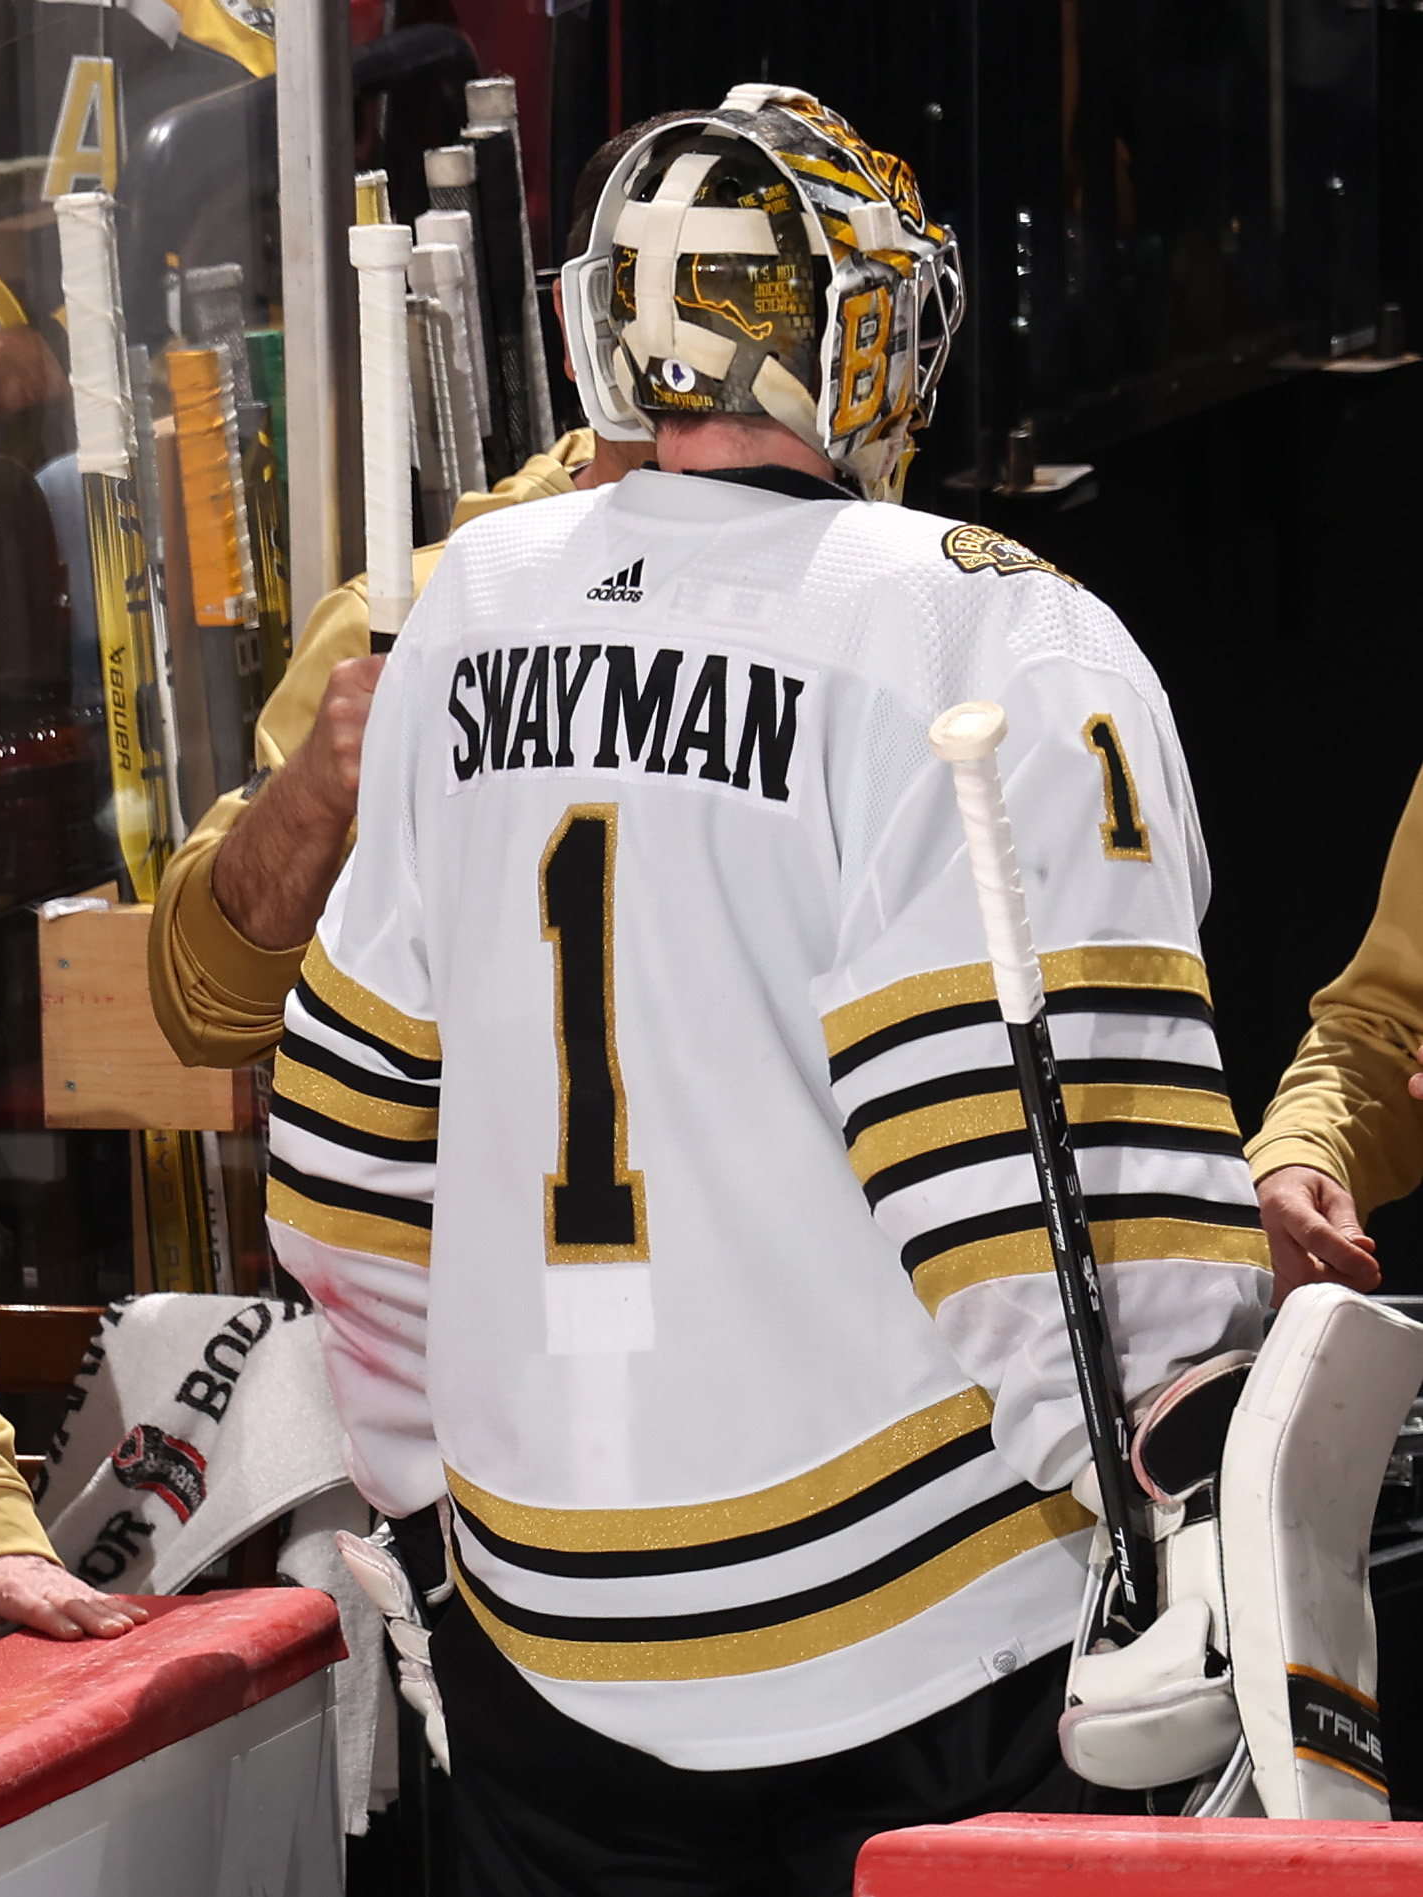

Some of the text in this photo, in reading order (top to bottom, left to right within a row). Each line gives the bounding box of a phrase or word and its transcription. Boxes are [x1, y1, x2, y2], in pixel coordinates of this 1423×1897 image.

[41, 55, 117, 202] A
[833, 287, 893, 436] B
[587, 585, 643, 603] adidas
[109, 668, 131, 772] BAUER
[448, 644, 805, 802] SWAYMAN
[1081, 712, 1152, 863] 1
[538, 802, 650, 1266] 1
[1114, 1526, 1137, 1604] TRUE
[1304, 1702, 1384, 1764] TRUE
